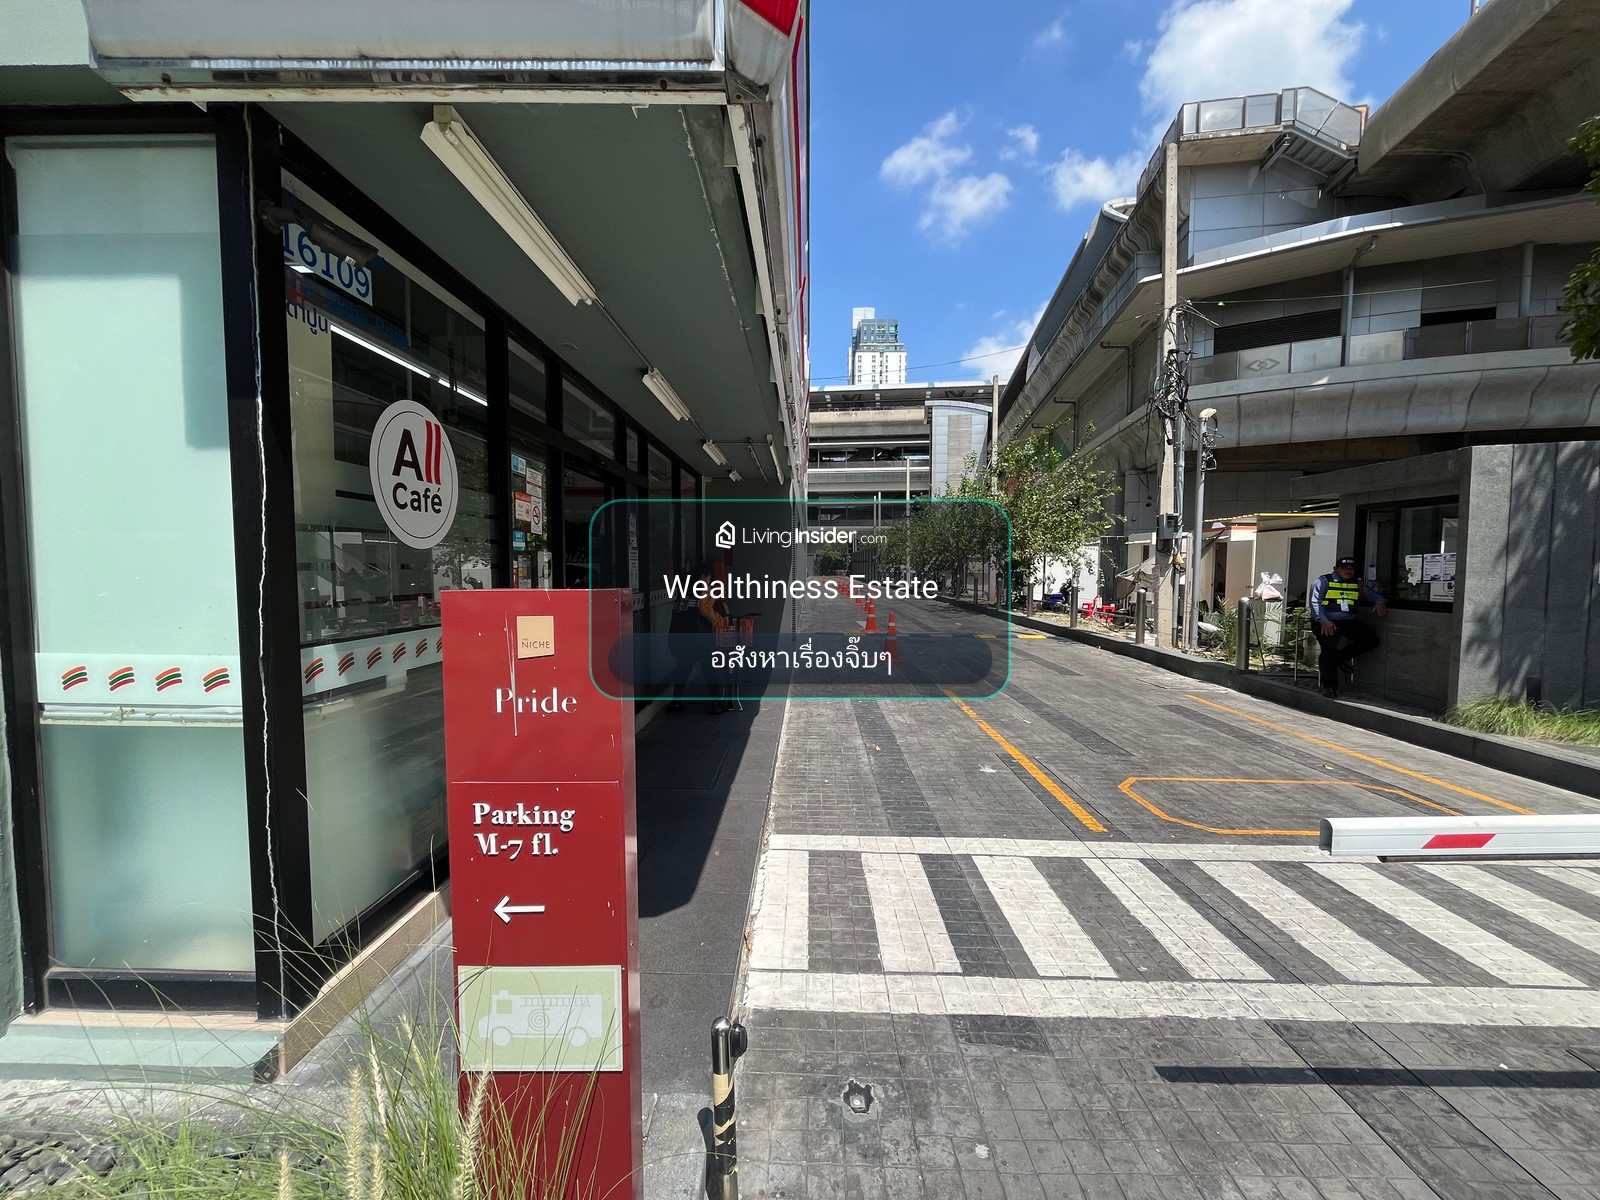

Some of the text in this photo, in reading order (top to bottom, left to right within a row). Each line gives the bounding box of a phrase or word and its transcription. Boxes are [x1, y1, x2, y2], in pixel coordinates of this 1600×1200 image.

[392, 419, 442, 486] All
[392, 481, 443, 514] Café
[521, 640, 551, 649] NICHE
[495, 686, 578, 714] Pride
[472, 802, 576, 832] Parking
[474, 833, 560, 860] M-7 fl.
